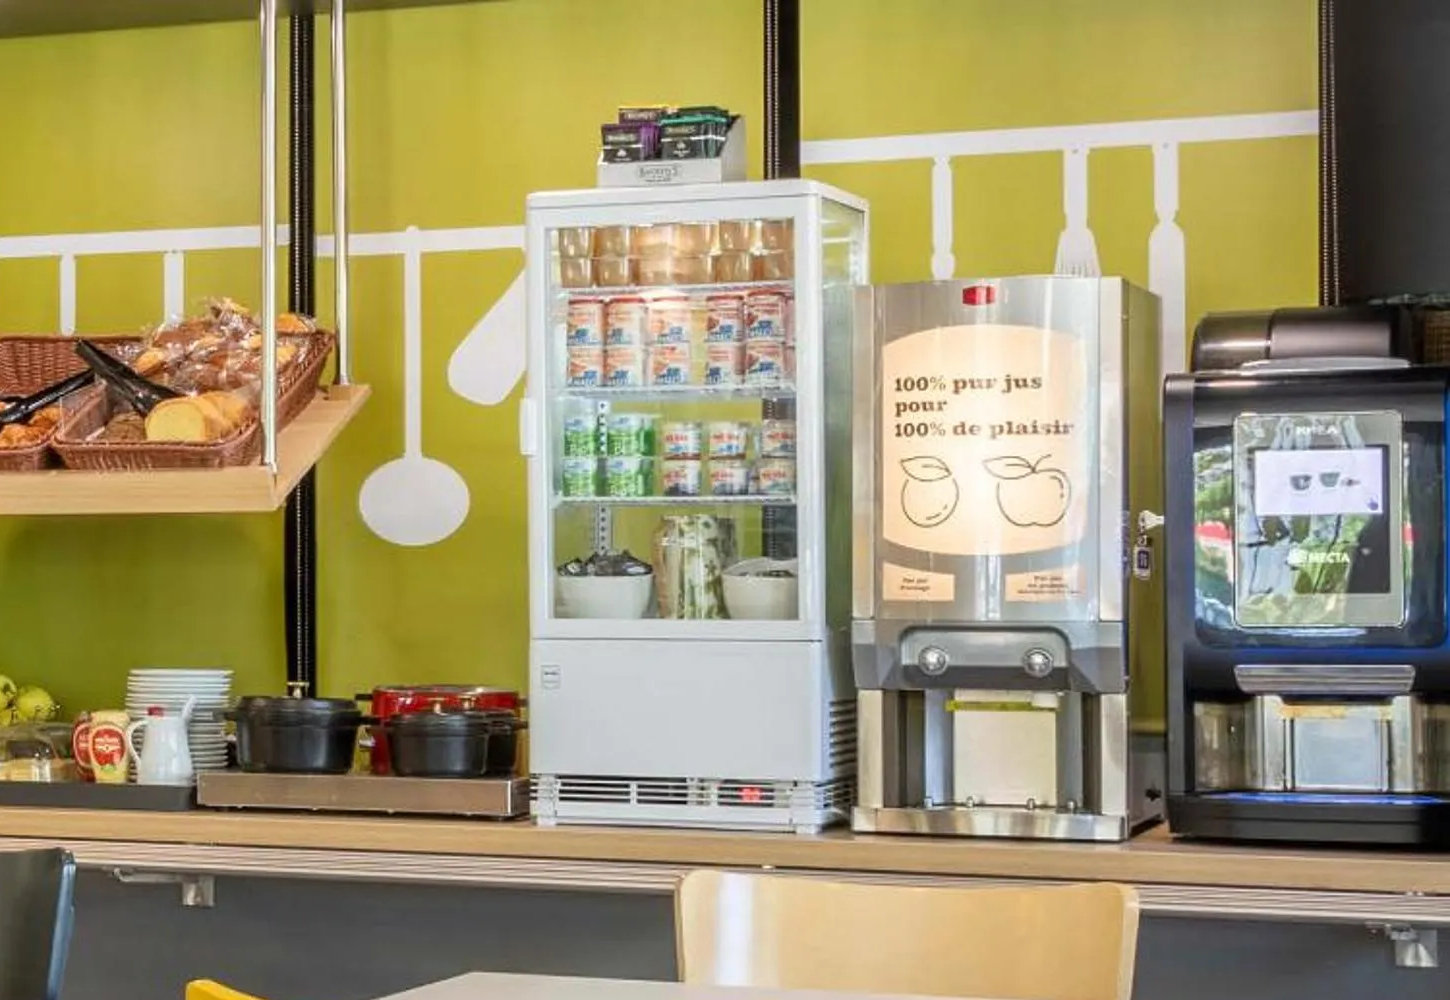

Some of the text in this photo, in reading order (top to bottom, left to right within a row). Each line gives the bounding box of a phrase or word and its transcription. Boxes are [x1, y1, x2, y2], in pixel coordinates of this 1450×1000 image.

[894, 374, 1043, 395] 100% pur jus
[894, 399, 948, 418] pour
[894, 419, 1075, 440] 100% de plaisir
